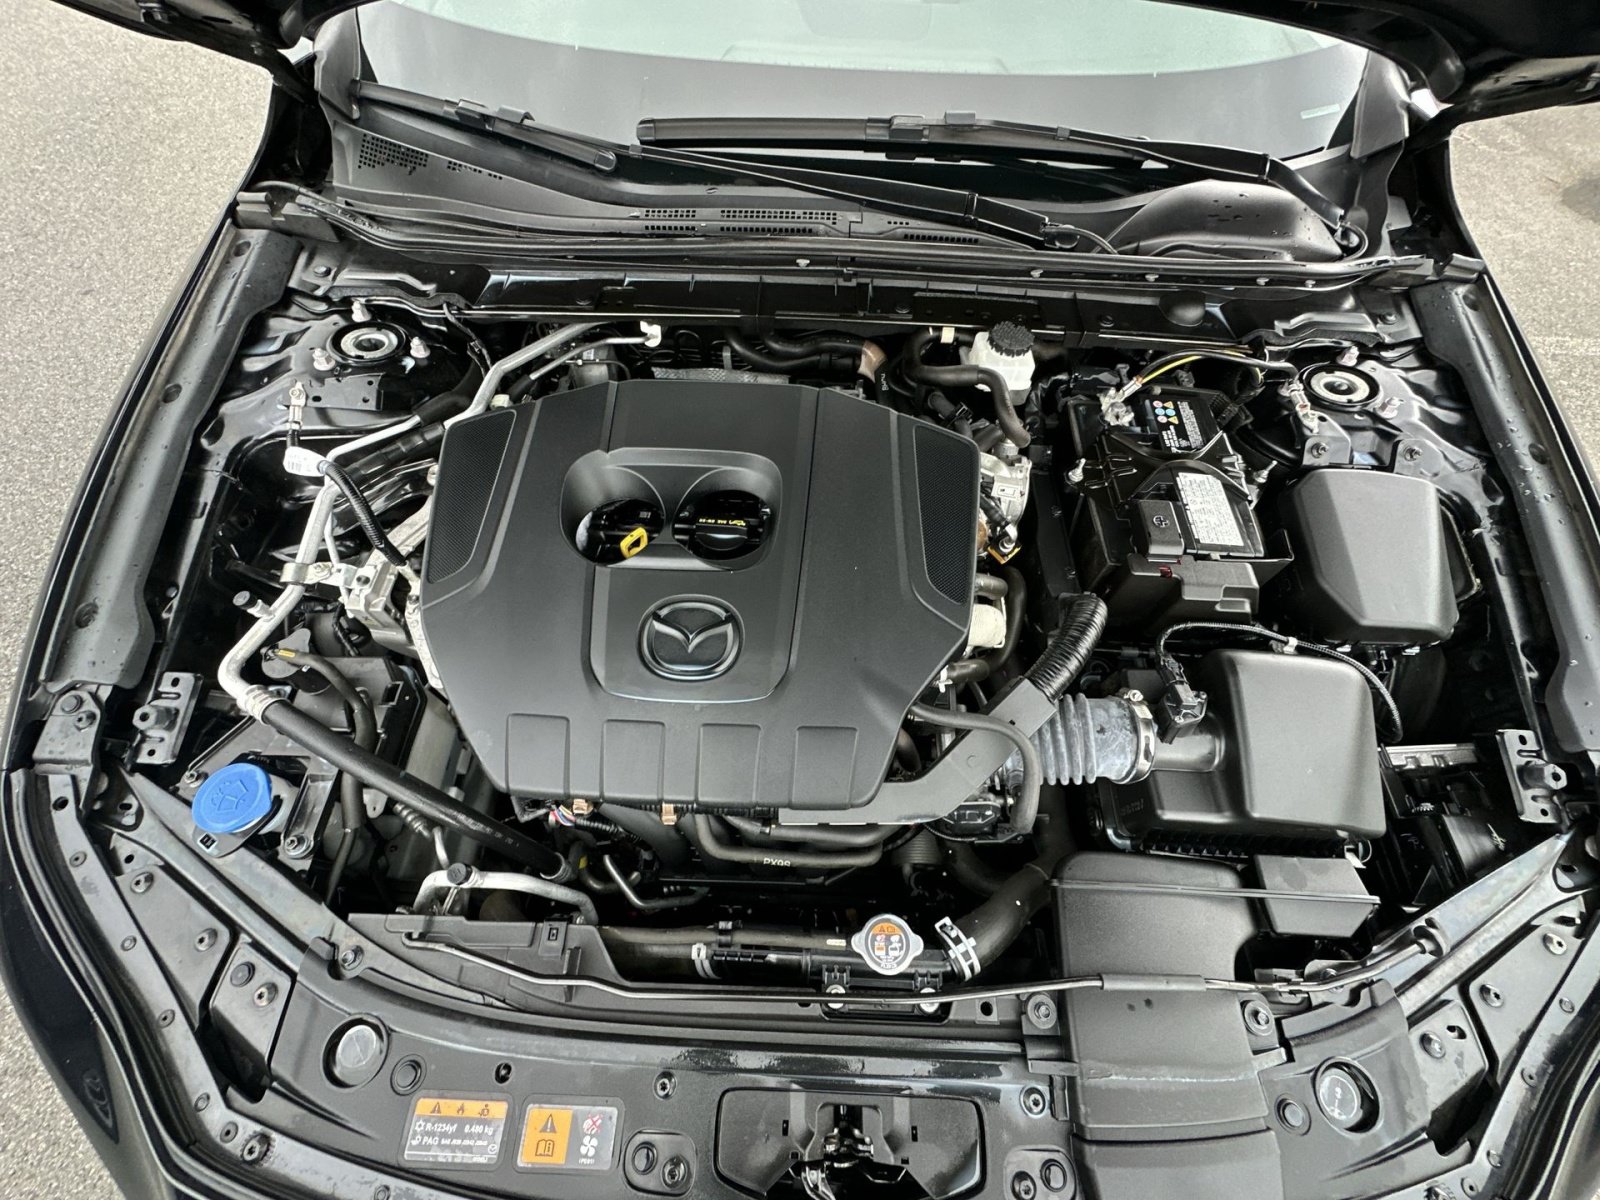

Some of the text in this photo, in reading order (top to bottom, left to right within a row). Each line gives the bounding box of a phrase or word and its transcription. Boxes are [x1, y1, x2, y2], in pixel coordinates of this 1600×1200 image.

[425, 1122, 458, 1135] R-1234yf
[484, 1125, 494, 1136] kg
[422, 1136, 440, 1145] PAG
